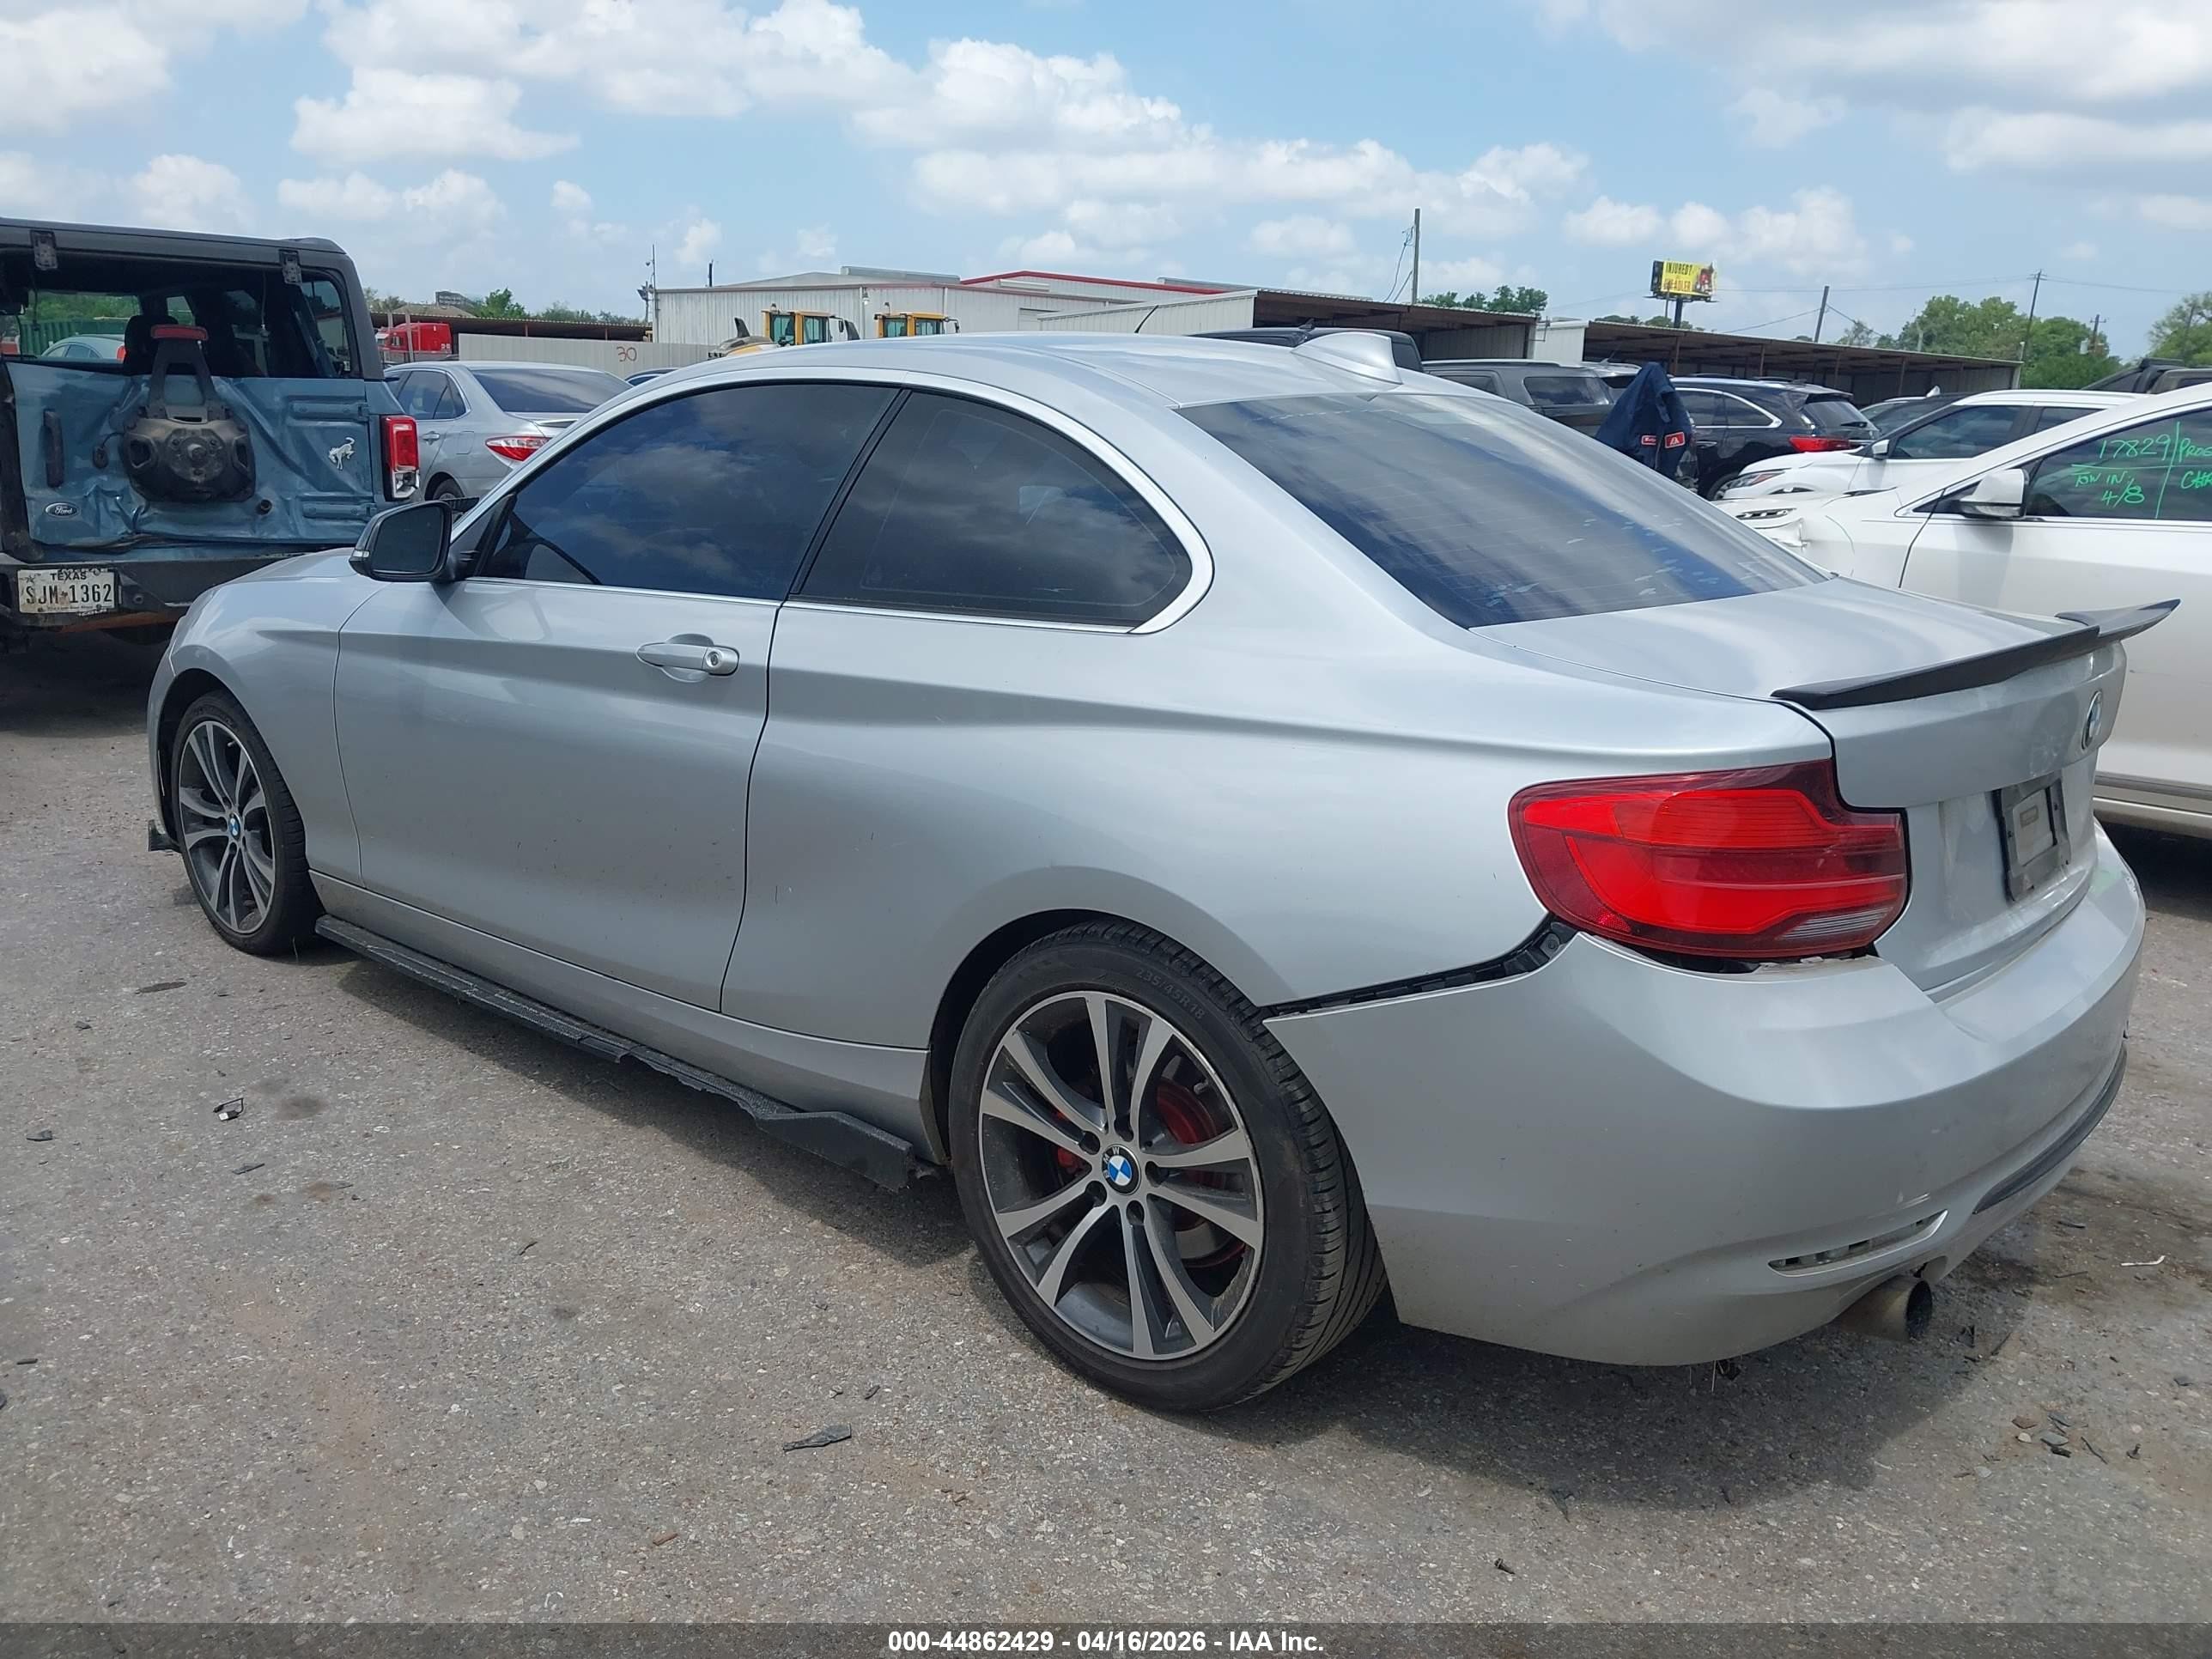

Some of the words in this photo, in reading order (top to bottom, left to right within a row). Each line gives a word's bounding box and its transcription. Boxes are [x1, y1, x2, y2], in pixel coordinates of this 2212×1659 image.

[617, 346, 637, 362] 30
[2100, 434, 2171, 461] 17829
[2071, 471, 2102, 487] TOW
[2102, 477, 2145, 508] 4/8
[55, 505, 73, 515] Ford
[50, 571, 87, 580] TEXAS
[69, 584, 112, 604] 1362
